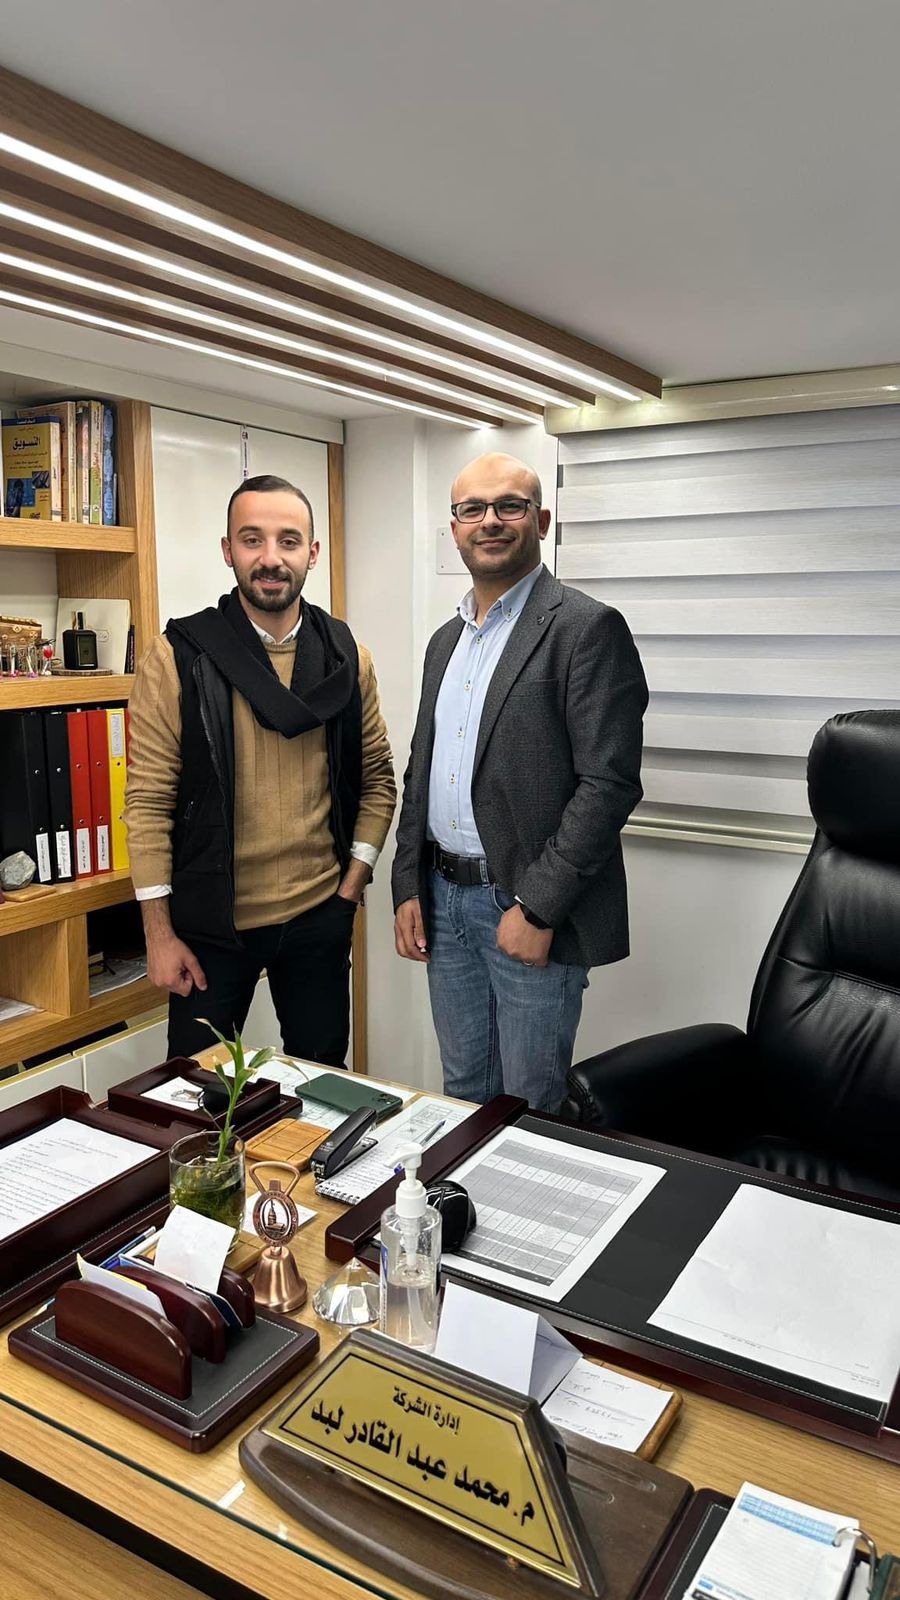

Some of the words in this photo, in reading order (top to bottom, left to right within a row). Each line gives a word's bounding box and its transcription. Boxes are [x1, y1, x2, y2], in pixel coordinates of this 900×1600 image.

[13, 436, 40, 450] التسويق
[311, 1400, 344, 1434] لبد
[393, 1386, 431, 1417] الشركة
[433, 1405, 460, 1435] إدارة
[344, 1420, 402, 1458] القادر
[407, 1444, 447, 1480] عبد
